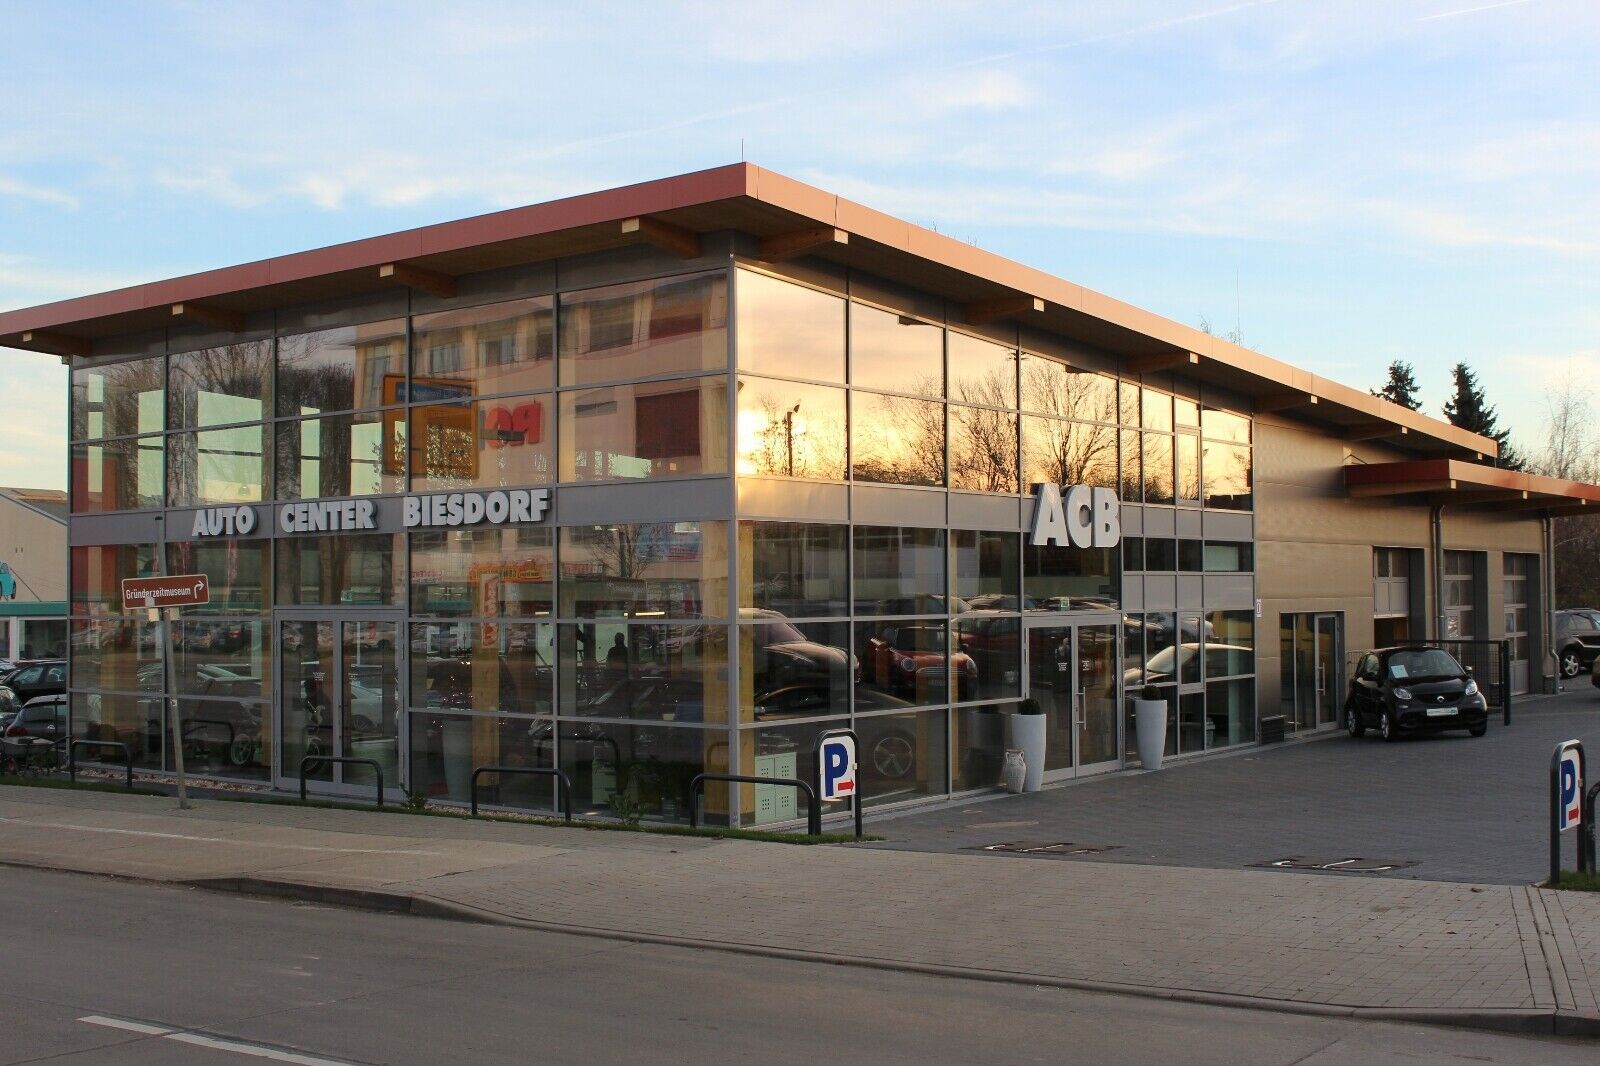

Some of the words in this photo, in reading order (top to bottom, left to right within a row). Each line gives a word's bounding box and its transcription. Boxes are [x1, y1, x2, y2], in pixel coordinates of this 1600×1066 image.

[192, 505, 256, 537] AUTO
[280, 499, 376, 533] CENTER
[403, 488, 549, 527] BIESDORF
[1029, 482, 1121, 549] ACB
[126, 587, 191, 600] Gründerzeitmuseum
[824, 743, 849, 797] P
[1560, 759, 1576, 830] P
